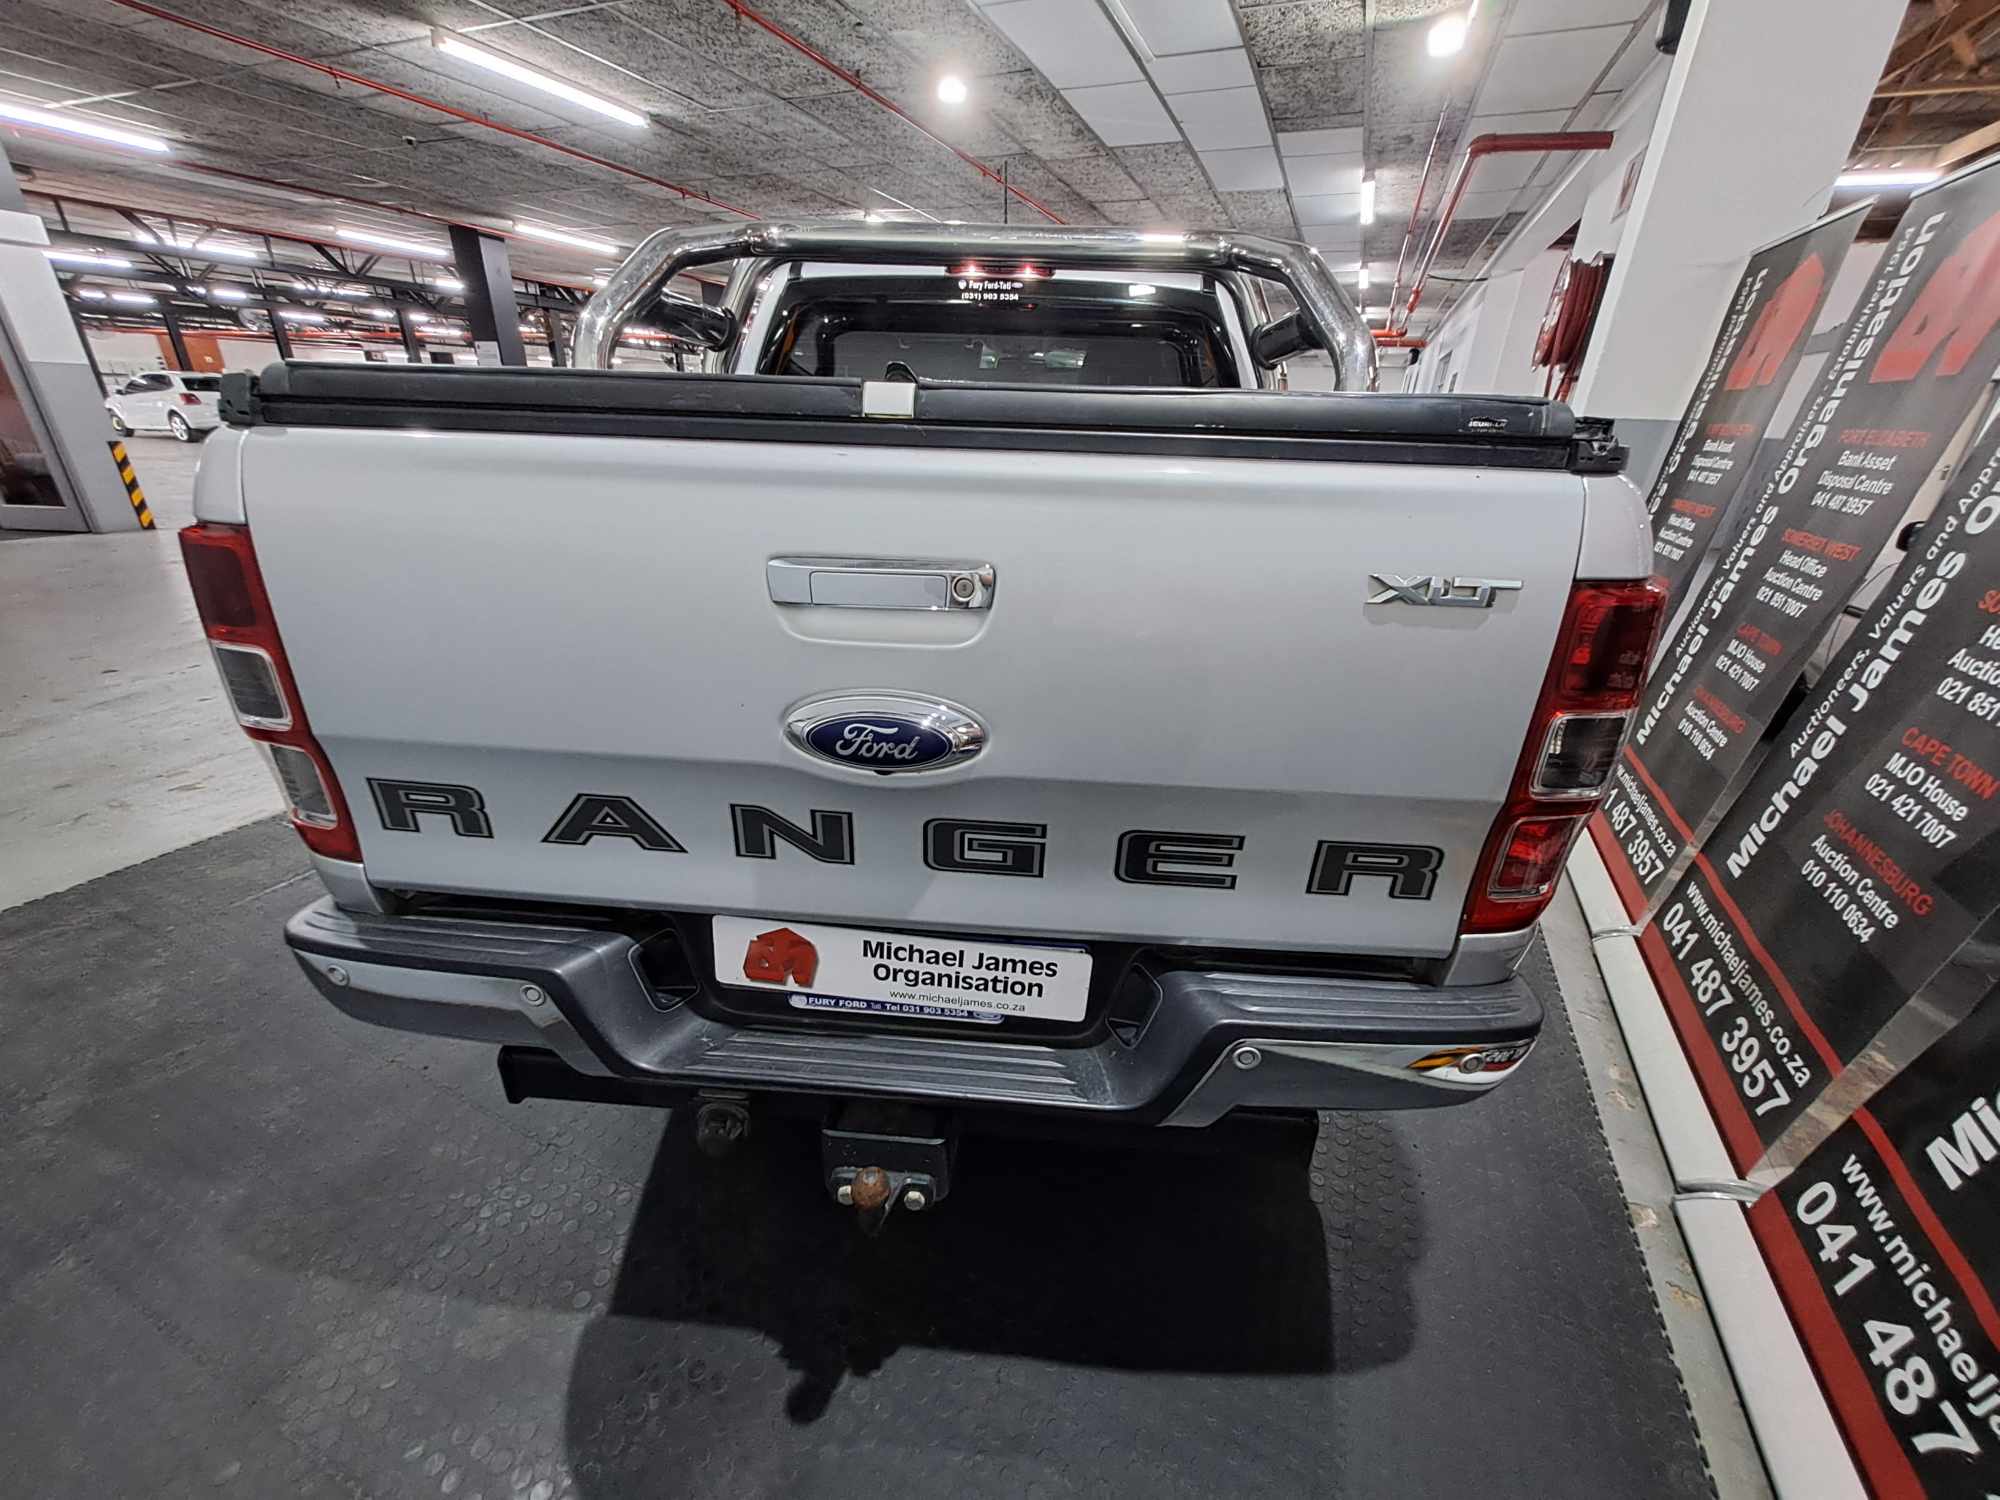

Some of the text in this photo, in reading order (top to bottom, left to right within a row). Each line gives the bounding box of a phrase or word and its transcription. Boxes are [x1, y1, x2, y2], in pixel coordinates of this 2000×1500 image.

[1636, 623, 1710, 746] Michael
[1711, 505, 1779, 620] James
[1777, 211, 1946, 494] Organisation
[1755, 482, 1775, 514] and
[1853, 474, 1894, 495] Centre
[1862, 452, 1898, 471] Asset
[1364, 573, 1524, 609] XLT
[1791, 578, 1823, 601] Centre
[1789, 648, 1871, 760] Auctioneers,
[1868, 564, 1927, 640] Valuers
[1926, 515, 1959, 560] and
[1726, 714, 1848, 879] Michael
[1848, 551, 1967, 713] James
[1936, 676, 2000, 721] 021 851
[834, 723, 921, 761] Ford
[1902, 726, 2000, 800] CAPE TOWN
[1864, 773, 1957, 849] 021 421 7007
[1884, 751, 1969, 822] MJO House
[366, 777, 1444, 900] RANGER
[1611, 800, 1638, 838] 487
[1627, 829, 1665, 885] 3957
[1801, 859, 1876, 944] 010 110 0634
[1811, 834, 1900, 930] Auction Centre
[861, 940, 1058, 978] Michael James
[872, 962, 1044, 999] Organisation
[1686, 880, 1812, 1088] www.michaeljames.co.za
[808, 997, 835, 1007] FURY
[839, 999, 867, 1009] FORD
[885, 1003, 900, 1011] Tel
[902, 1005, 920, 1013] 031
[923, 1006, 941, 1015] 903
[944, 1007, 968, 1017] 5354
[889, 990, 1026, 1013] www.michaeljames.co.za
[1662, 902, 1792, 1118] 041 487 3957
[1925, 1090, 2000, 1191] Mi
[1796, 1181, 1983, 1456] 041 487
